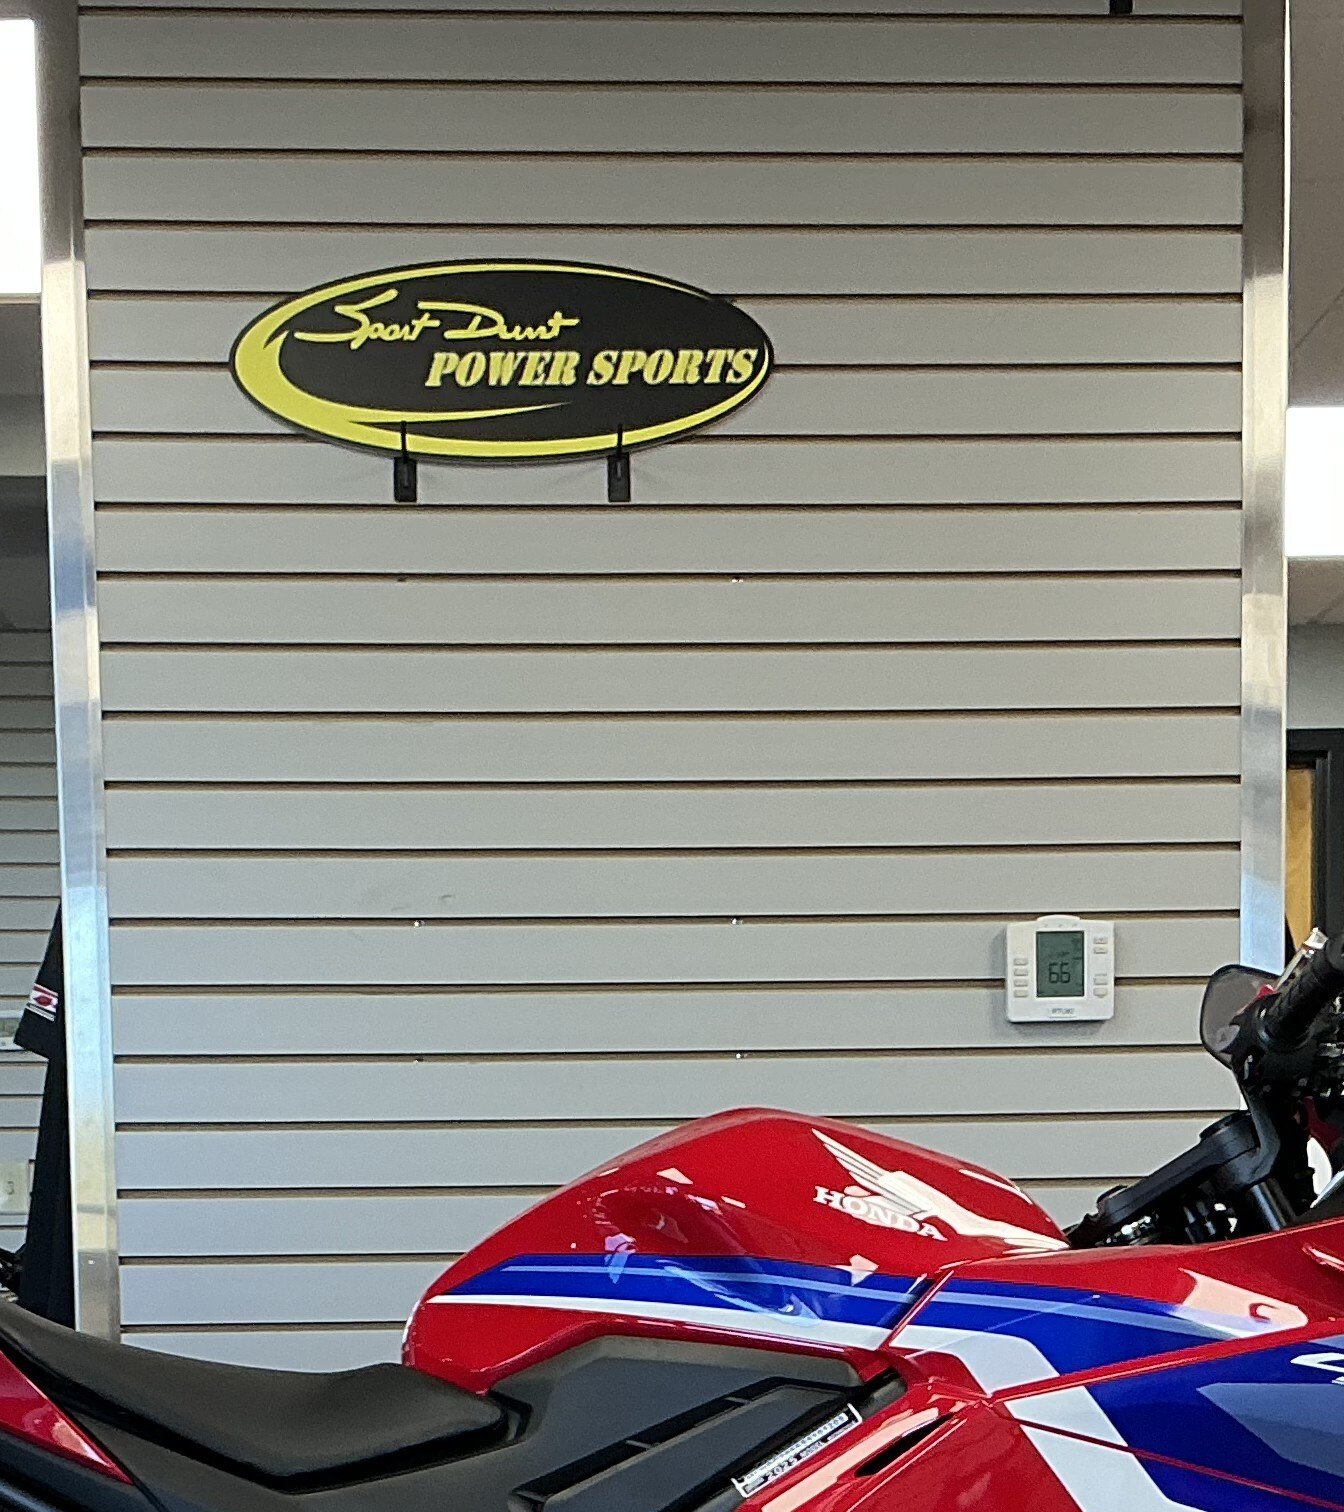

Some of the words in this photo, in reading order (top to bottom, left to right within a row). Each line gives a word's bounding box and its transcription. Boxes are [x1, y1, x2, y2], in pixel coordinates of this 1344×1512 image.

[294, 288, 441, 350] Sport
[424, 351, 581, 388] POWER
[586, 348, 759, 386] SPORTS
[1048, 961, 1072, 985] 66
[812, 1185, 949, 1242] HONDA
